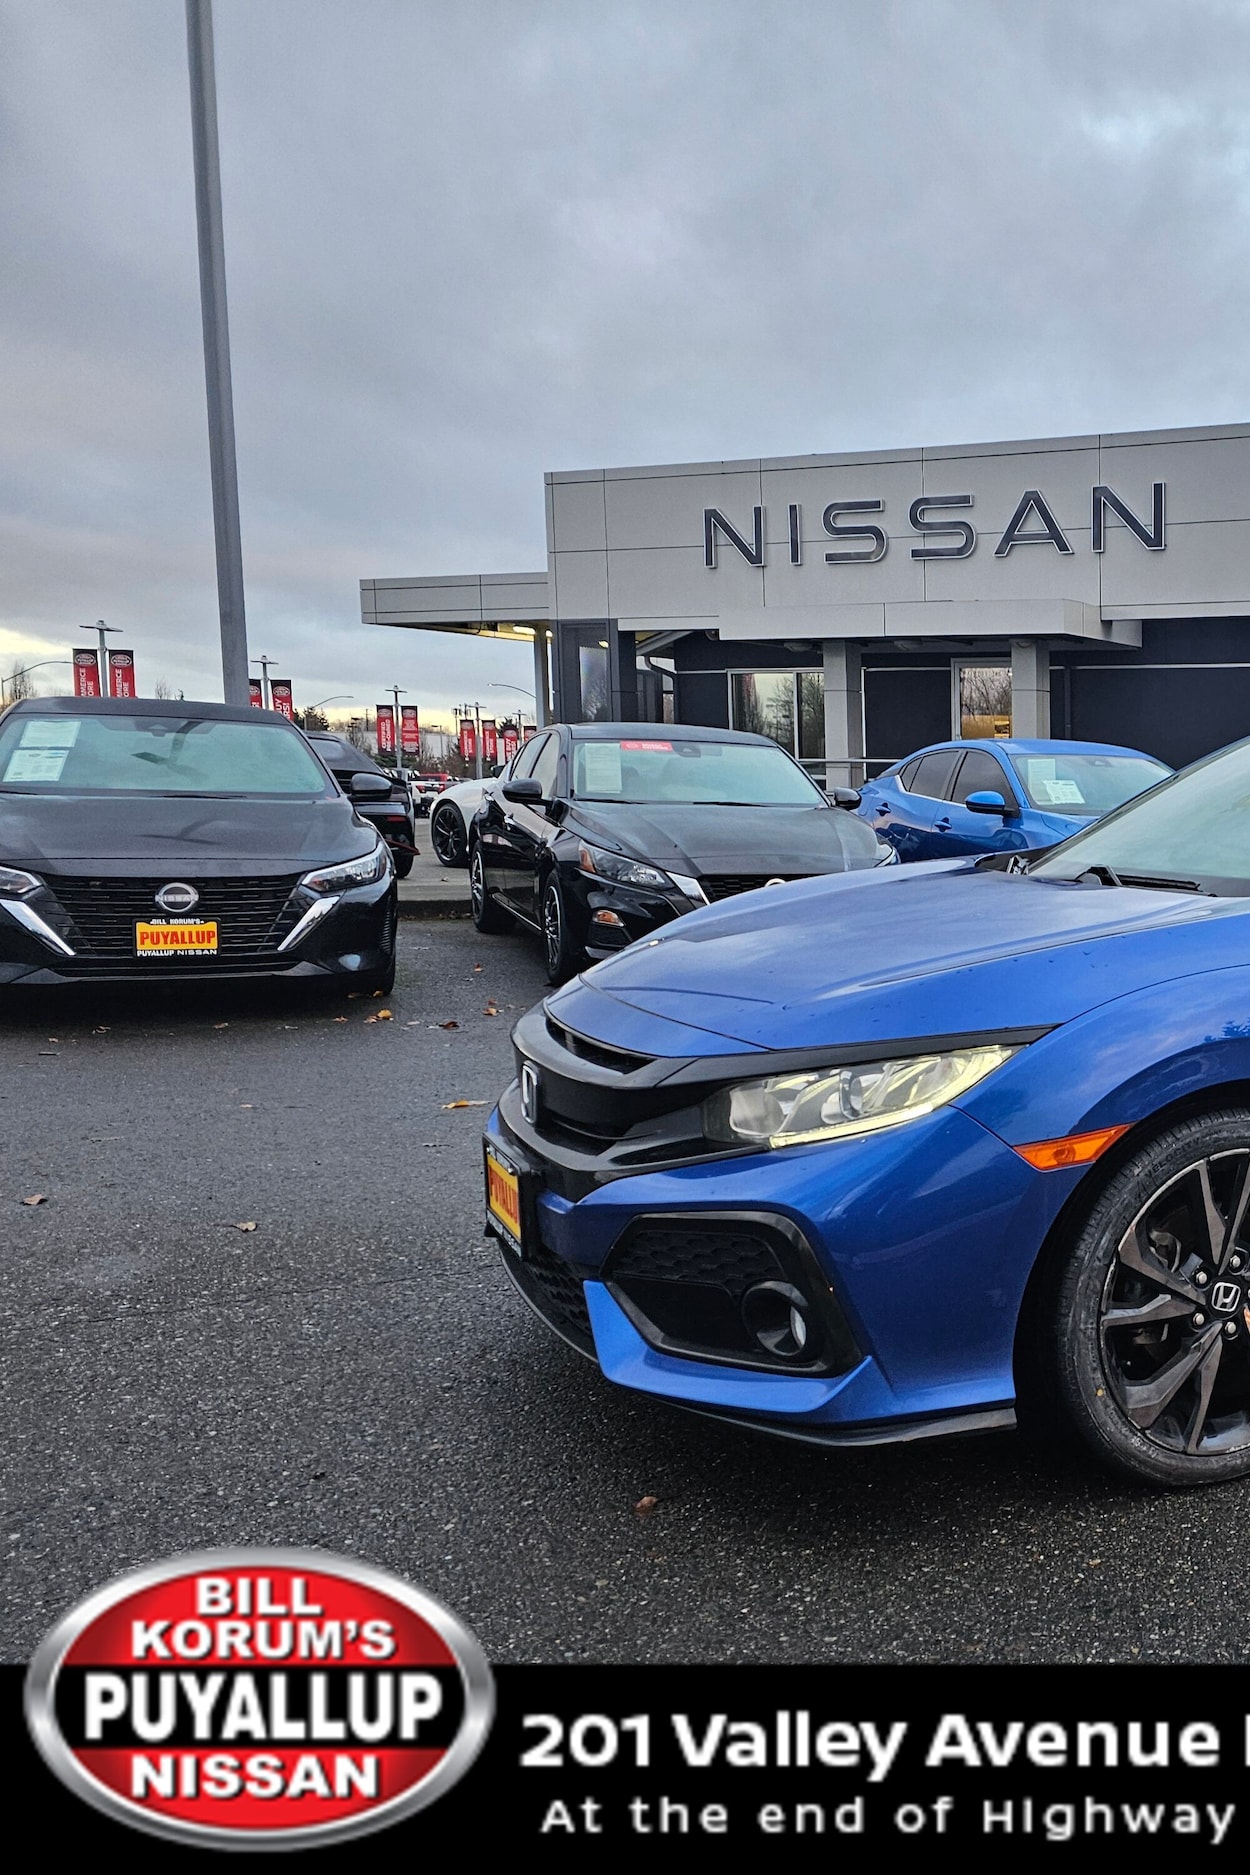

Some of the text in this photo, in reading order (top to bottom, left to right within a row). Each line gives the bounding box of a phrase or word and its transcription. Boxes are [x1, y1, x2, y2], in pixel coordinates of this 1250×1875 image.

[703, 481, 1167, 568] NISSAN
[139, 930, 216, 945] PUYALLUP
[137, 949, 174, 957] PUYALLUP
